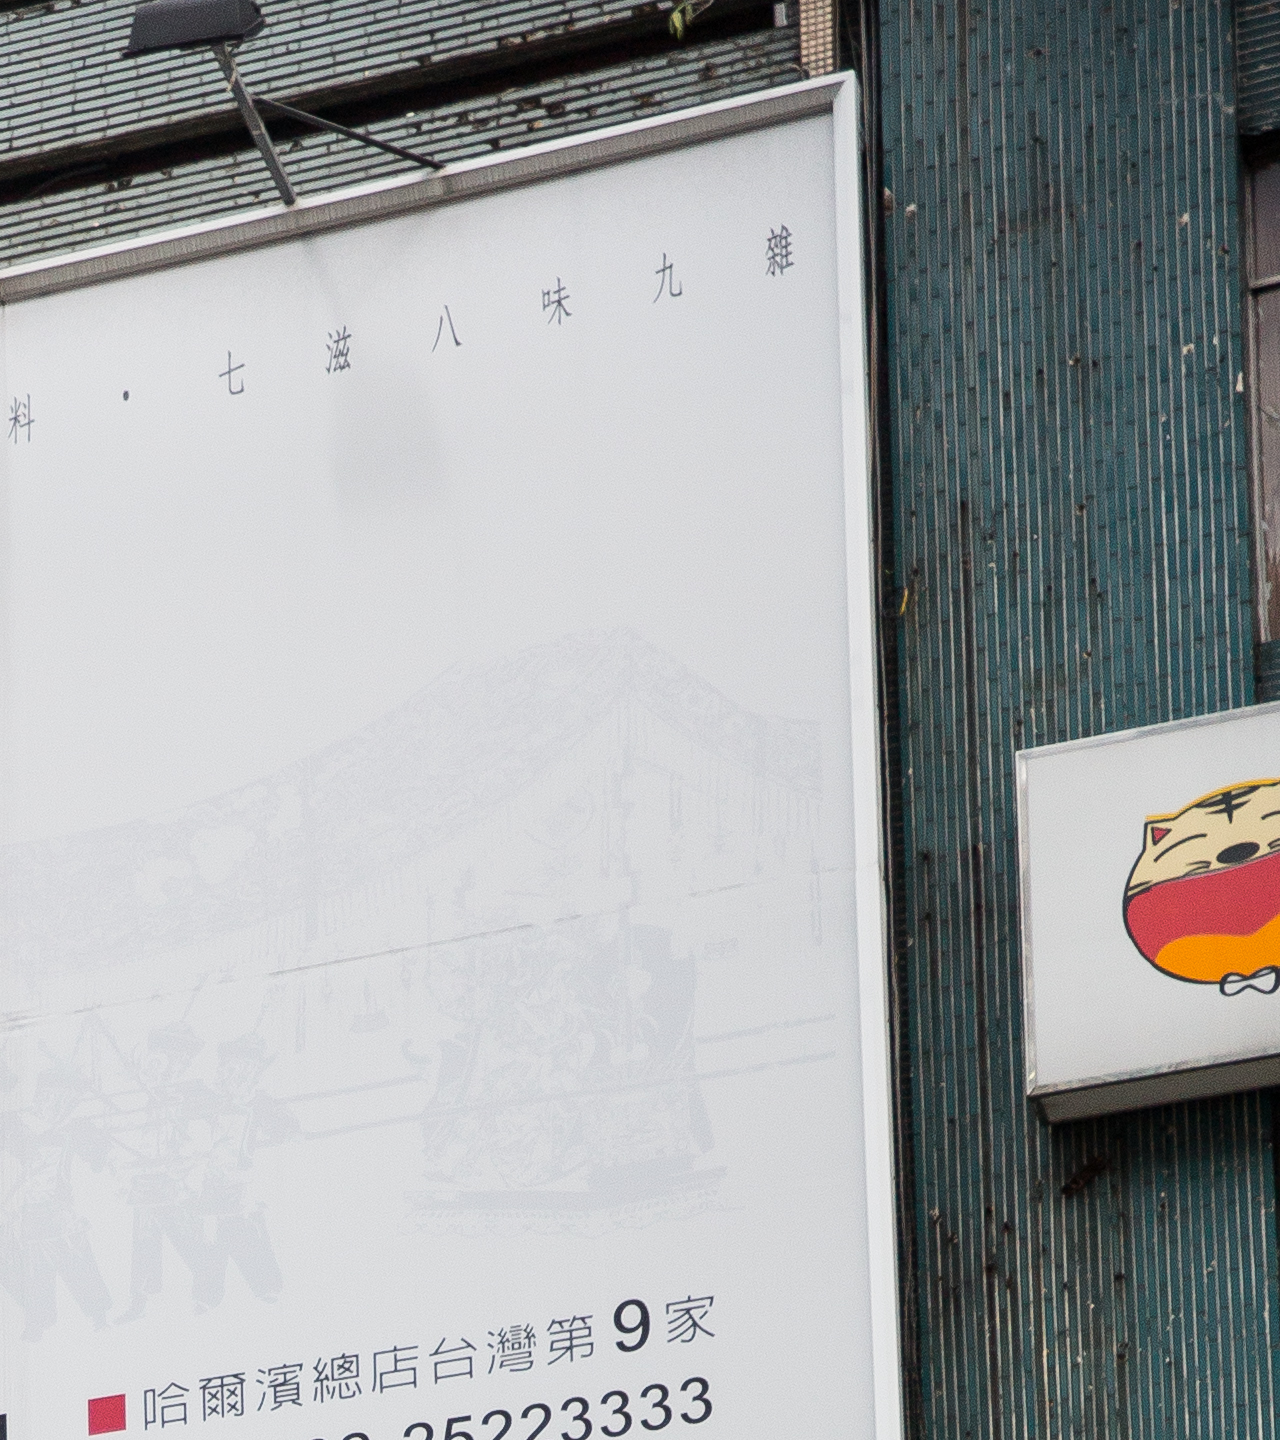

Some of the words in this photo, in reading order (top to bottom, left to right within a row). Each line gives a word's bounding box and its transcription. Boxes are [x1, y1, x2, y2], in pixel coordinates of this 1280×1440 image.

[142, 1295, 716, 1431] 哈爾濱總店台灣第9家
